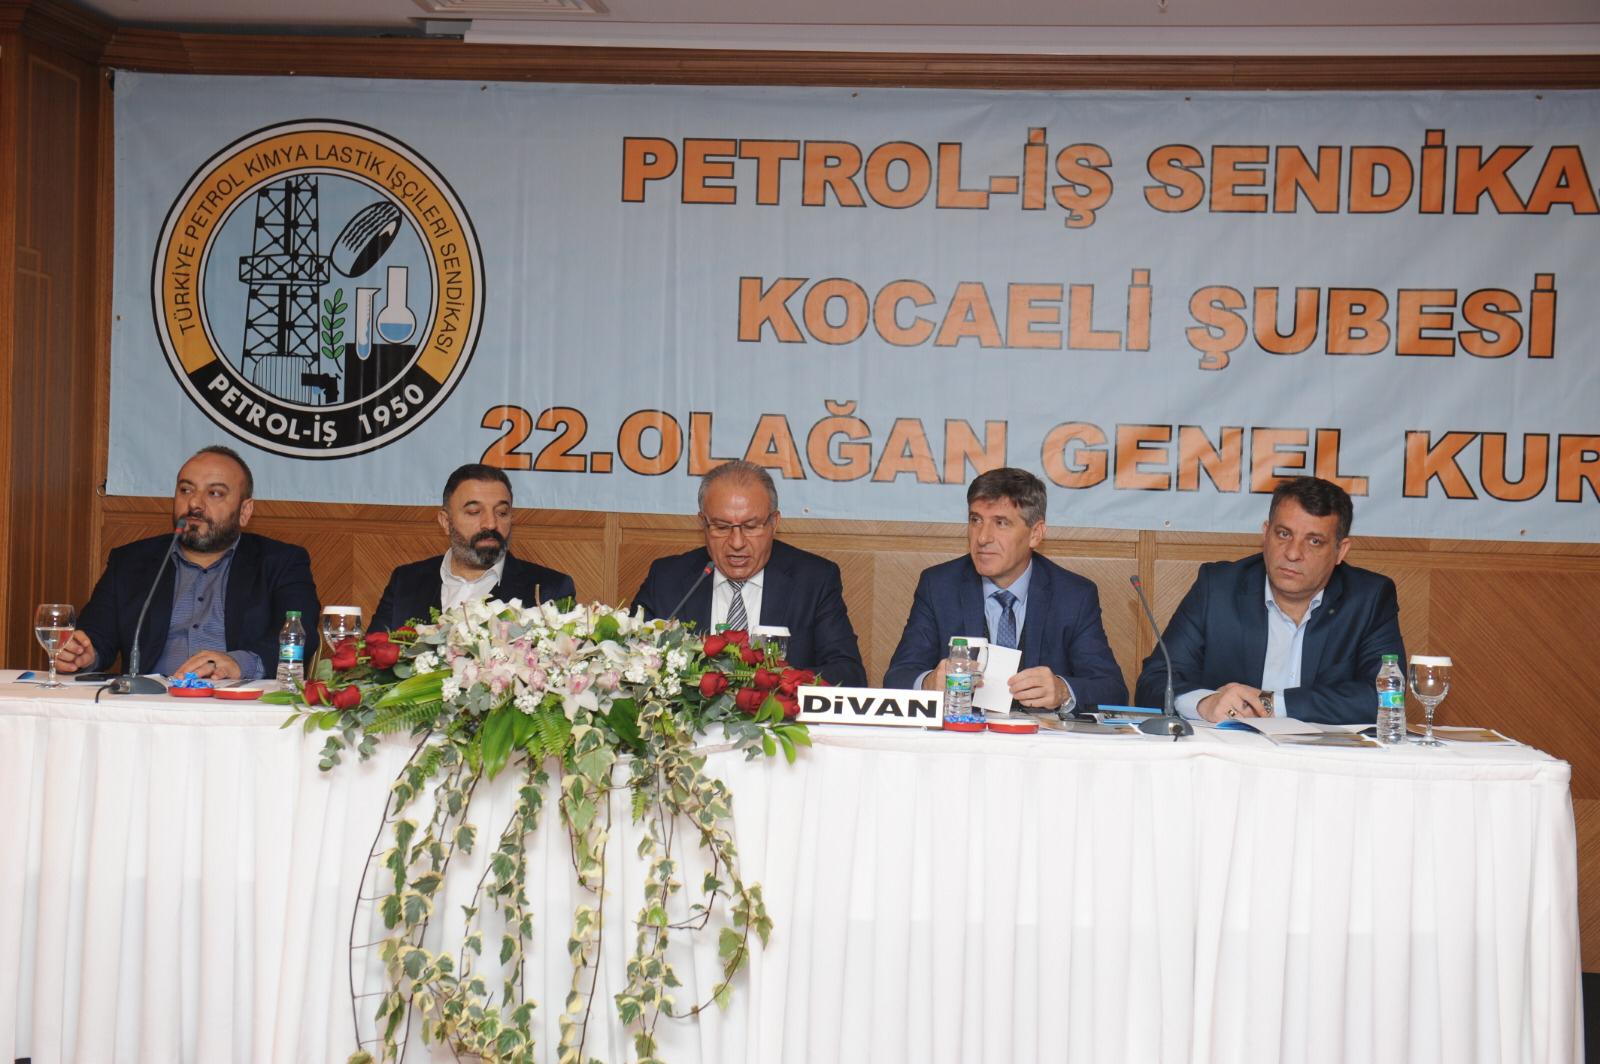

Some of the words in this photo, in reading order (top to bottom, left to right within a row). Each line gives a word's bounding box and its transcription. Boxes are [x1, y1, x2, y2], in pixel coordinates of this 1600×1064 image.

[622, 127, 1115, 229] PETROL-İŞ
[1143, 129, 1600, 215] SENDİKA
[171, 243, 196, 336] TÜRKİYE
[184, 173, 245, 241] PETROL
[244, 144, 309, 178] KİMYA
[315, 144, 387, 176] LASTİK
[386, 163, 453, 239] İŞÇİLERİ
[434, 242, 465, 355] SENDİKASI
[737, 268, 1153, 353] KOCAELİ
[1185, 273, 1558, 371] ŞUBESİ
[207, 373, 338, 448] PETROL-İŞ
[358, 383, 425, 435] 1950
[479, 399, 1009, 486] 22.OLAĞAN
[1040, 421, 1370, 497] GENEL
[1402, 430, 1600, 503] KUR
